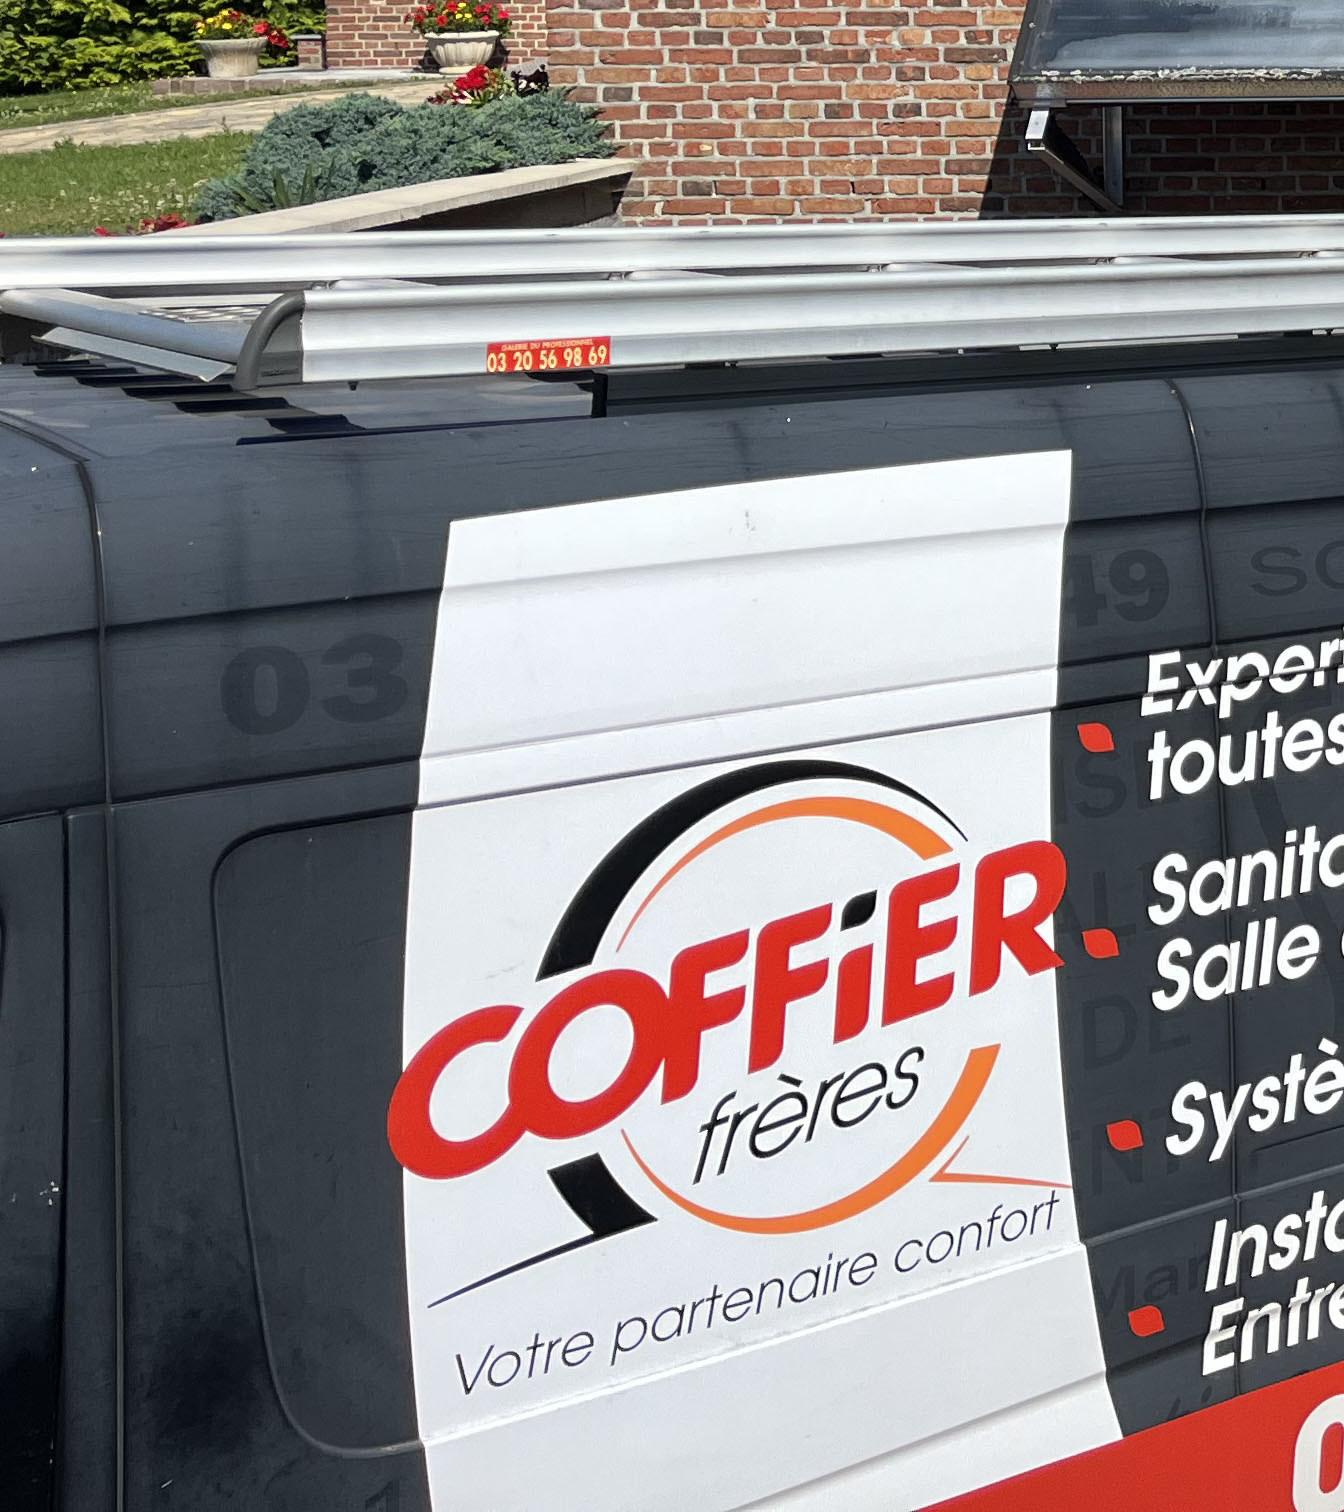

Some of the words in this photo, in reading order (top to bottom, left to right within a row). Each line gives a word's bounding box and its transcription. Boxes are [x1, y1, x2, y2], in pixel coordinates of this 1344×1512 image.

[487, 352, 507, 373] 03
[513, 350, 533, 371] 20
[539, 349, 558, 369] 56
[563, 347, 582, 367] 98
[588, 345, 607, 365] 69
[387, 839, 1068, 1181] COFFIER
[1151, 915, 1322, 1012] Salle
[691, 1045, 926, 1186] frères
[454, 1331, 595, 1397] Votre
[610, 1250, 879, 1368] partenaire
[893, 1189, 1062, 1274] confort
